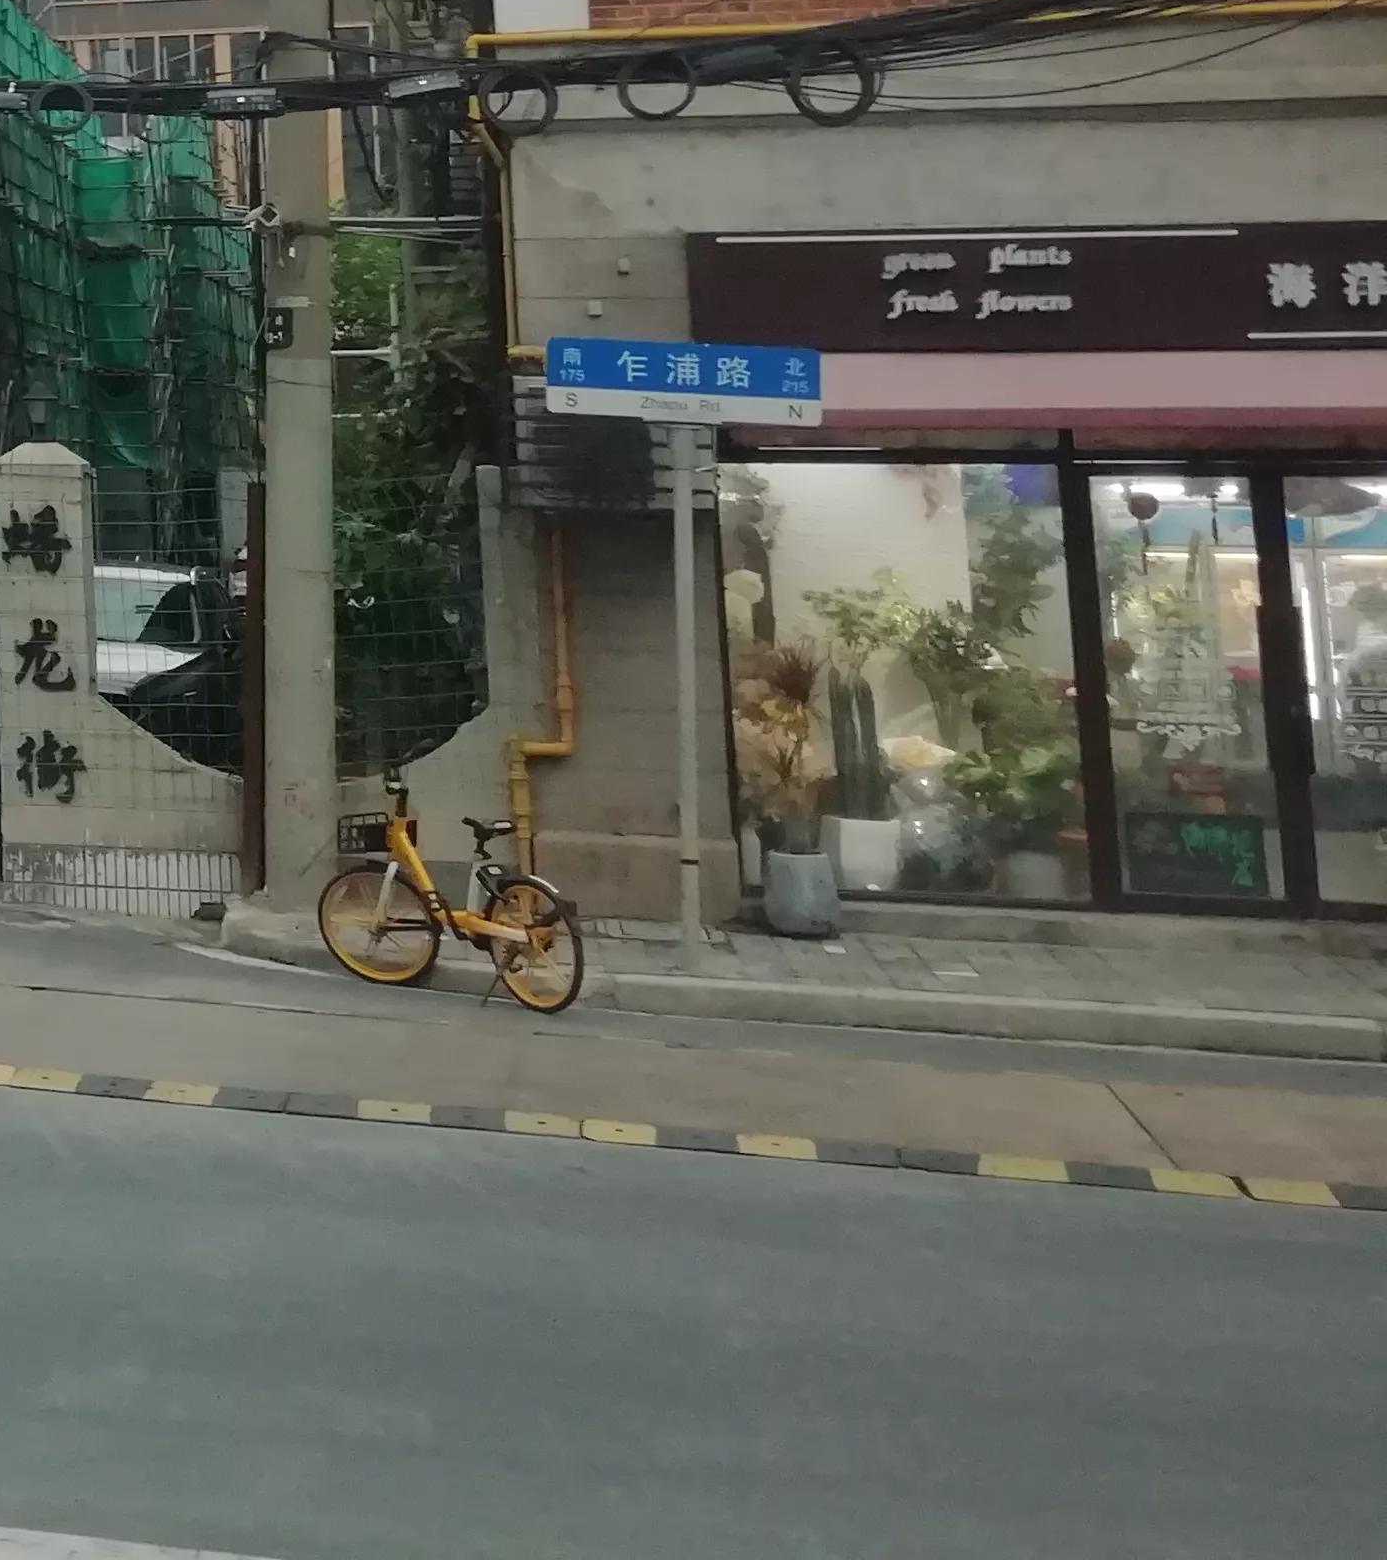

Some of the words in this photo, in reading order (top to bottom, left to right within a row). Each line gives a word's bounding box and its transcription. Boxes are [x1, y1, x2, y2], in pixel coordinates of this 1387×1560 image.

[988, 243, 1073, 274] plants
[975, 289, 1073, 319] flowers
[562, 347, 582, 366] 南
[559, 368, 586, 383] 175
[616, 349, 752, 389] 乍浦路
[784, 356, 806, 377] 北
[564, 392, 579, 408] S
[640, 396, 688, 411] Zhapu
[699, 399, 721, 413] Rd
[788, 405, 803, 420] N
